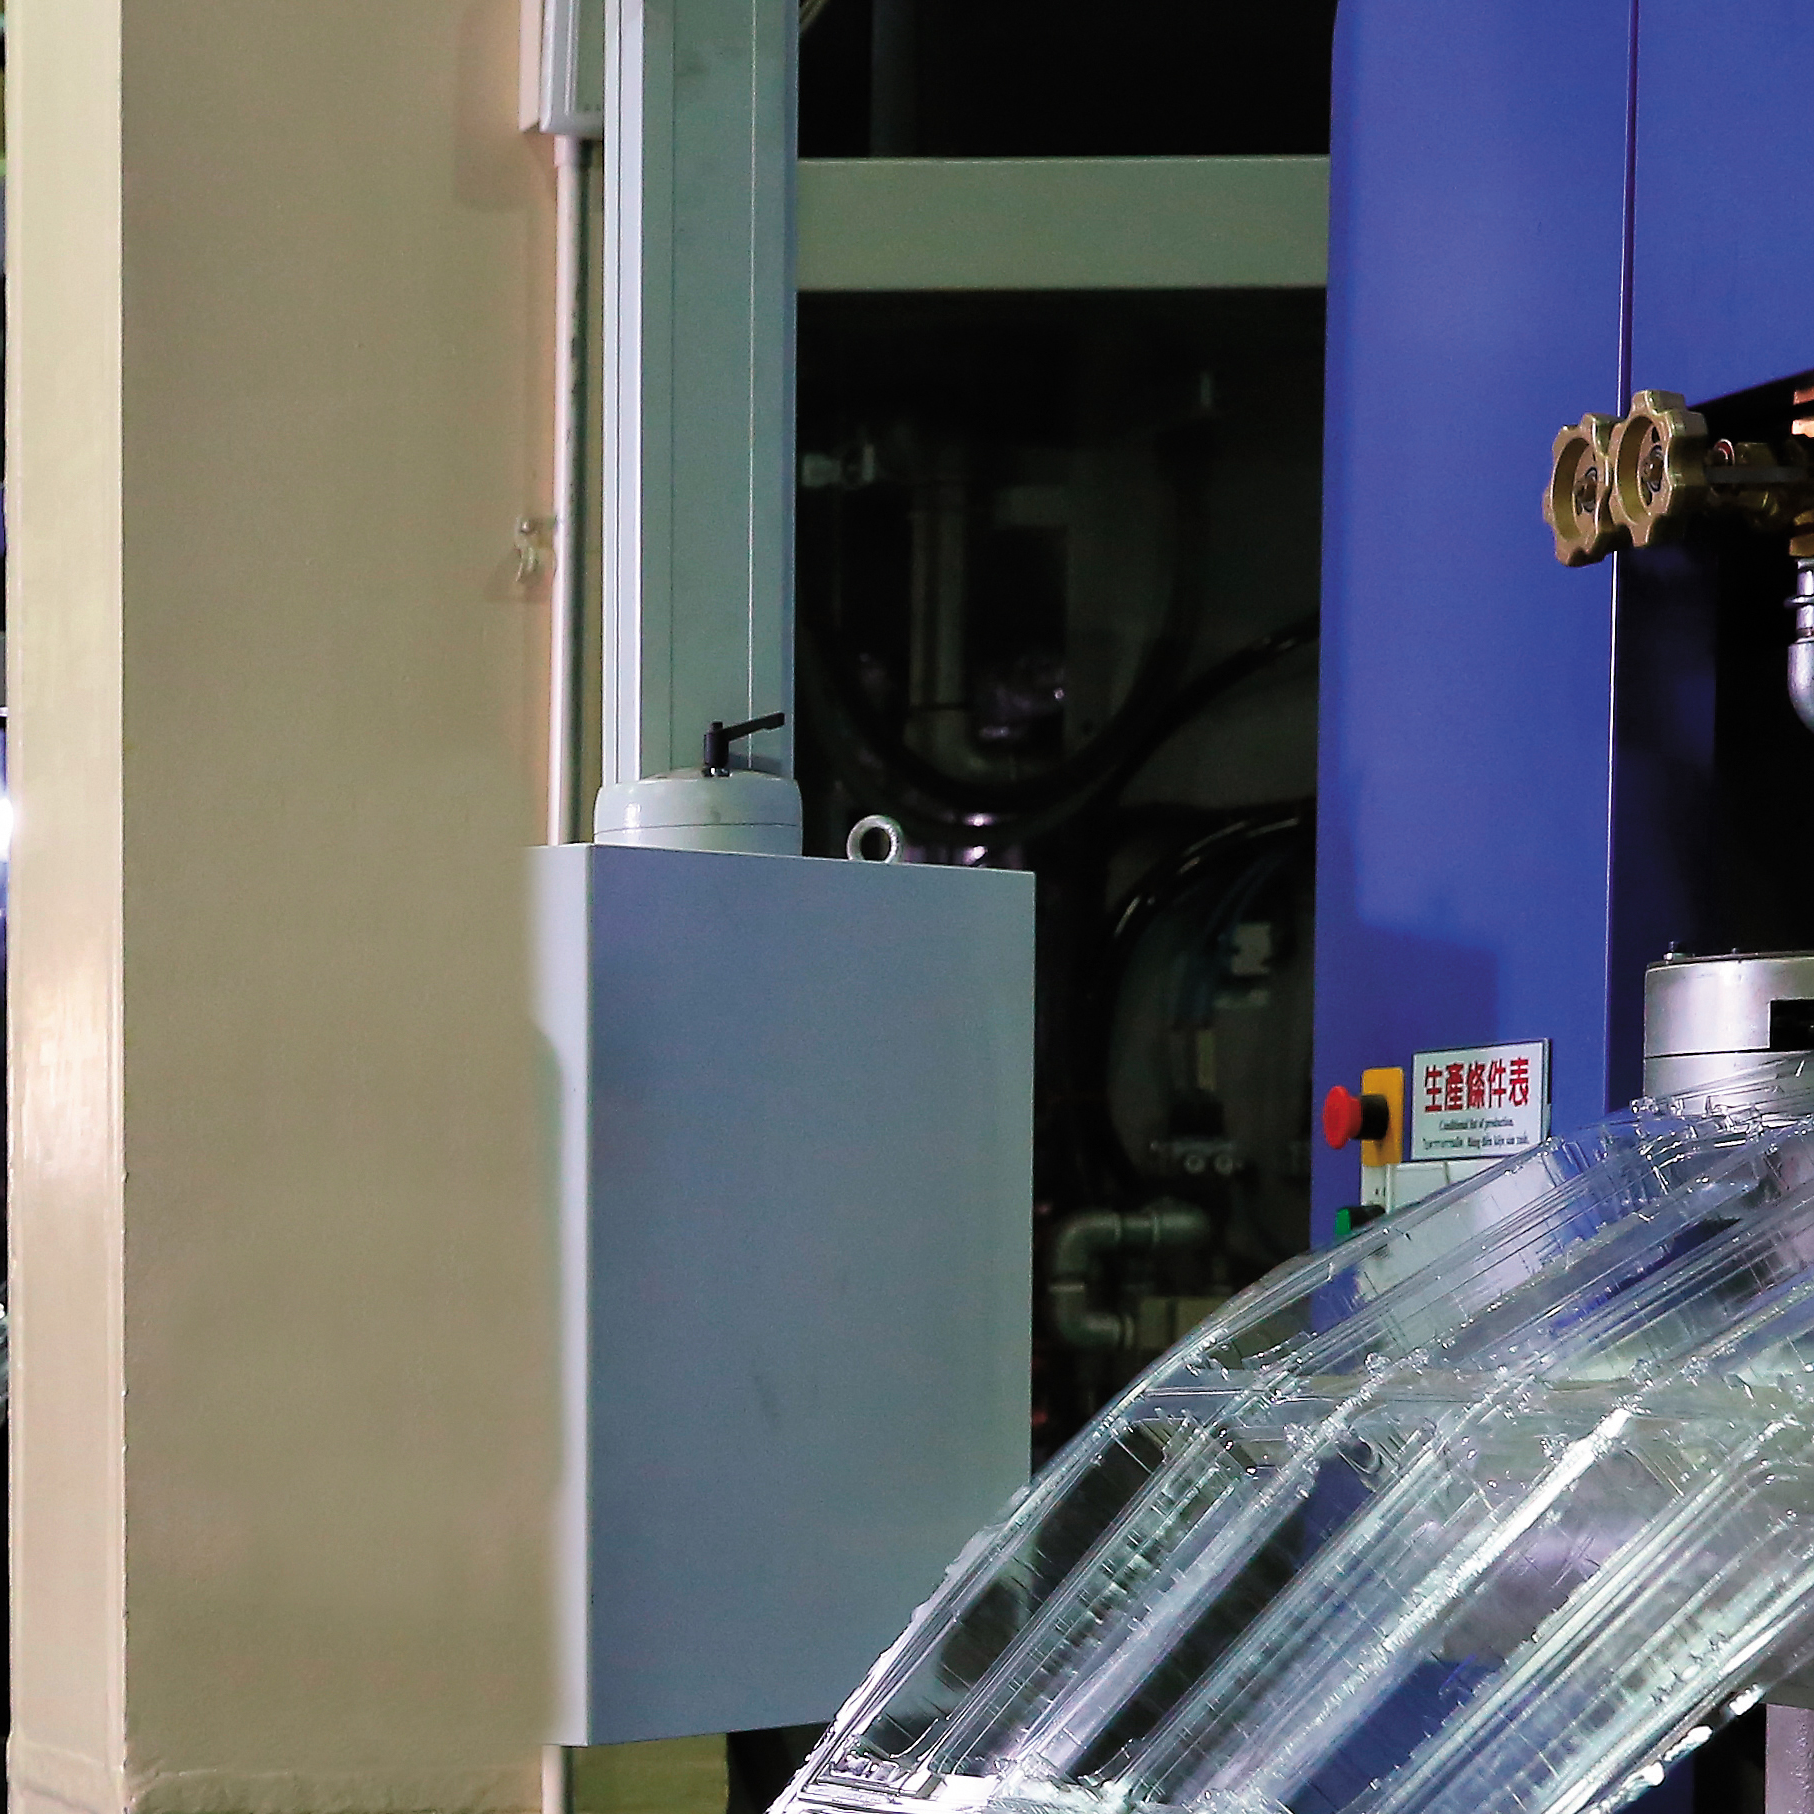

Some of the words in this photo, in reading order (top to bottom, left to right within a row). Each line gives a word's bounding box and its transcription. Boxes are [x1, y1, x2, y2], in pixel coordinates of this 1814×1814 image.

[1424, 1056, 1530, 1113] 生產條件表
